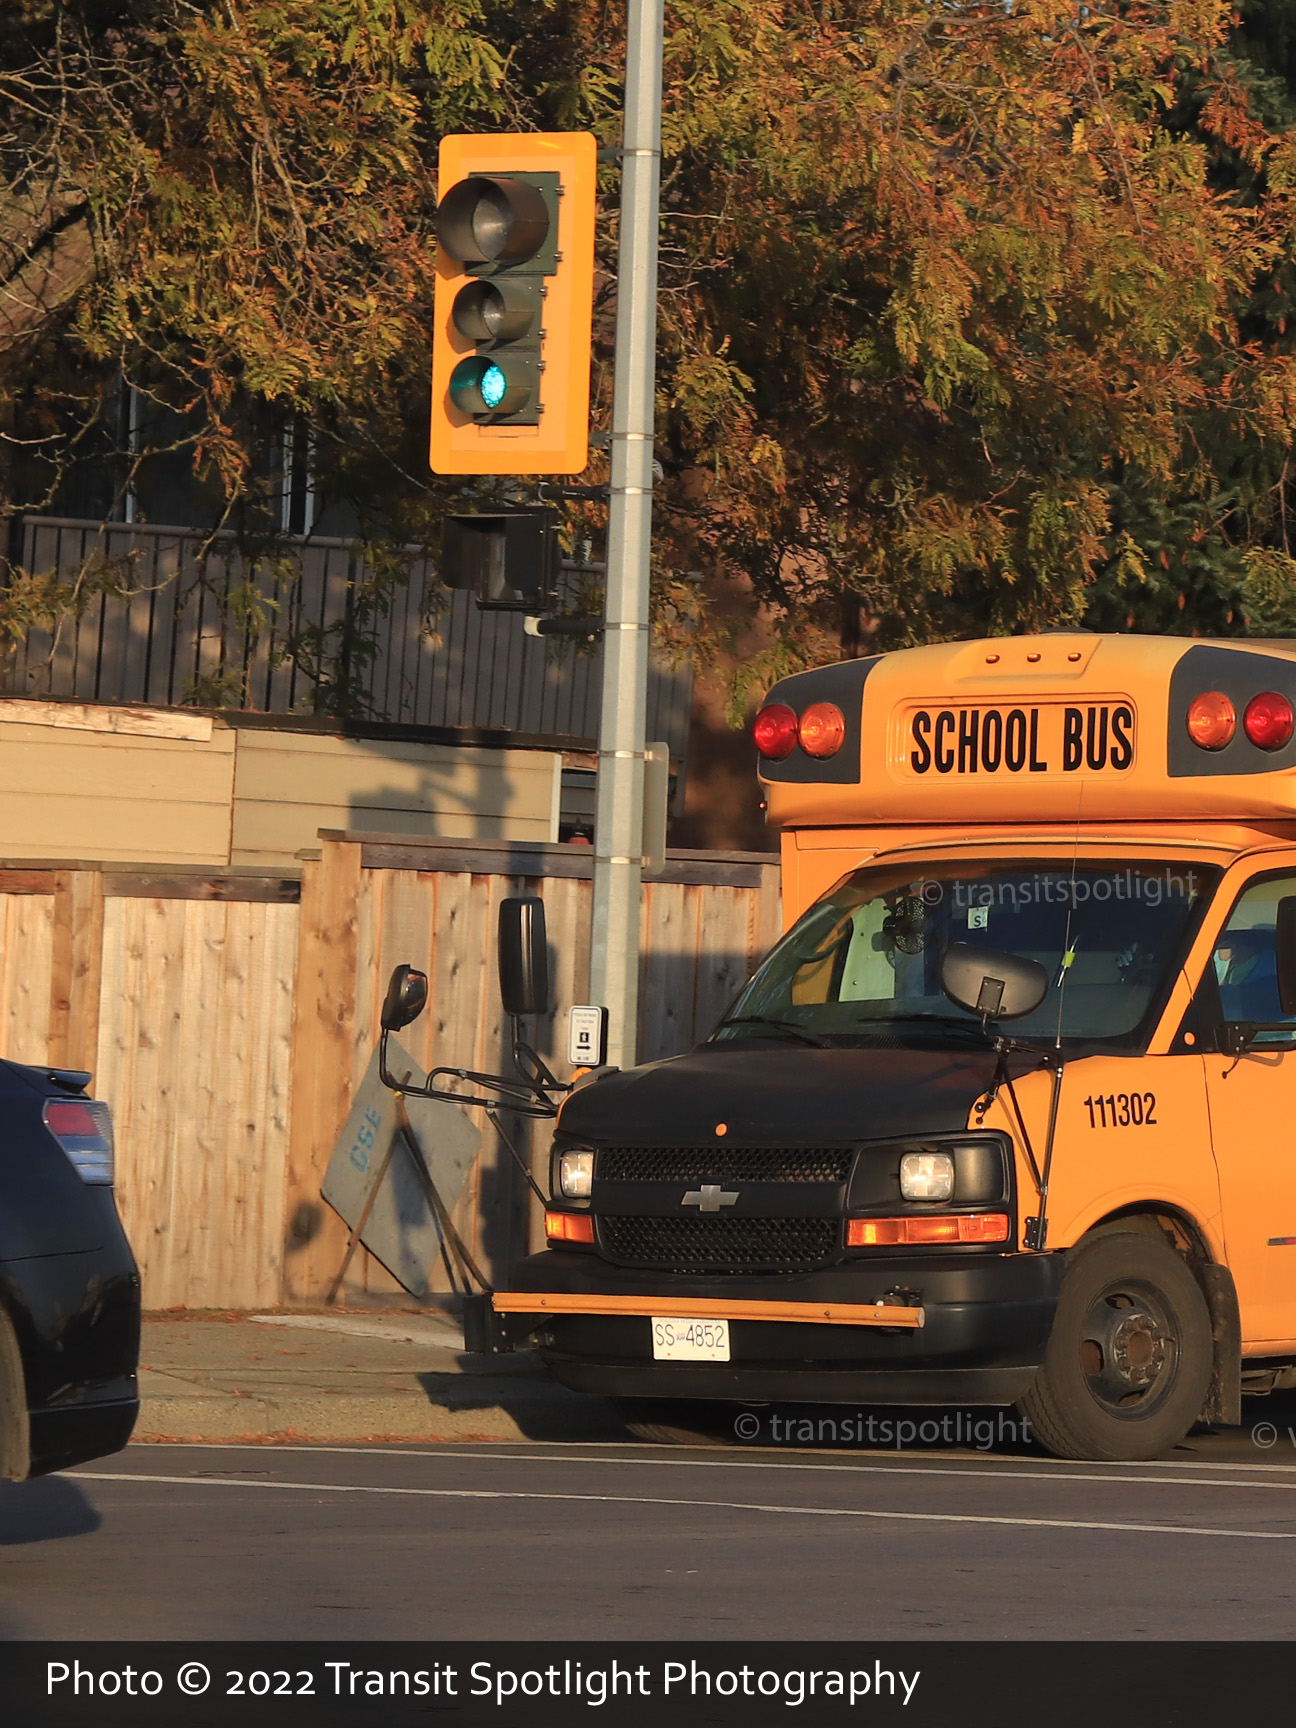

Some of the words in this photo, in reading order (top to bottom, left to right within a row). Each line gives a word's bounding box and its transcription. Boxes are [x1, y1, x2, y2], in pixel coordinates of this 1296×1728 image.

[911, 709, 1047, 774] SCHOOL
[1063, 707, 1132, 771] BUS
[350, 1104, 384, 1173] CSE
[1083, 1092, 1157, 1128] 111302
